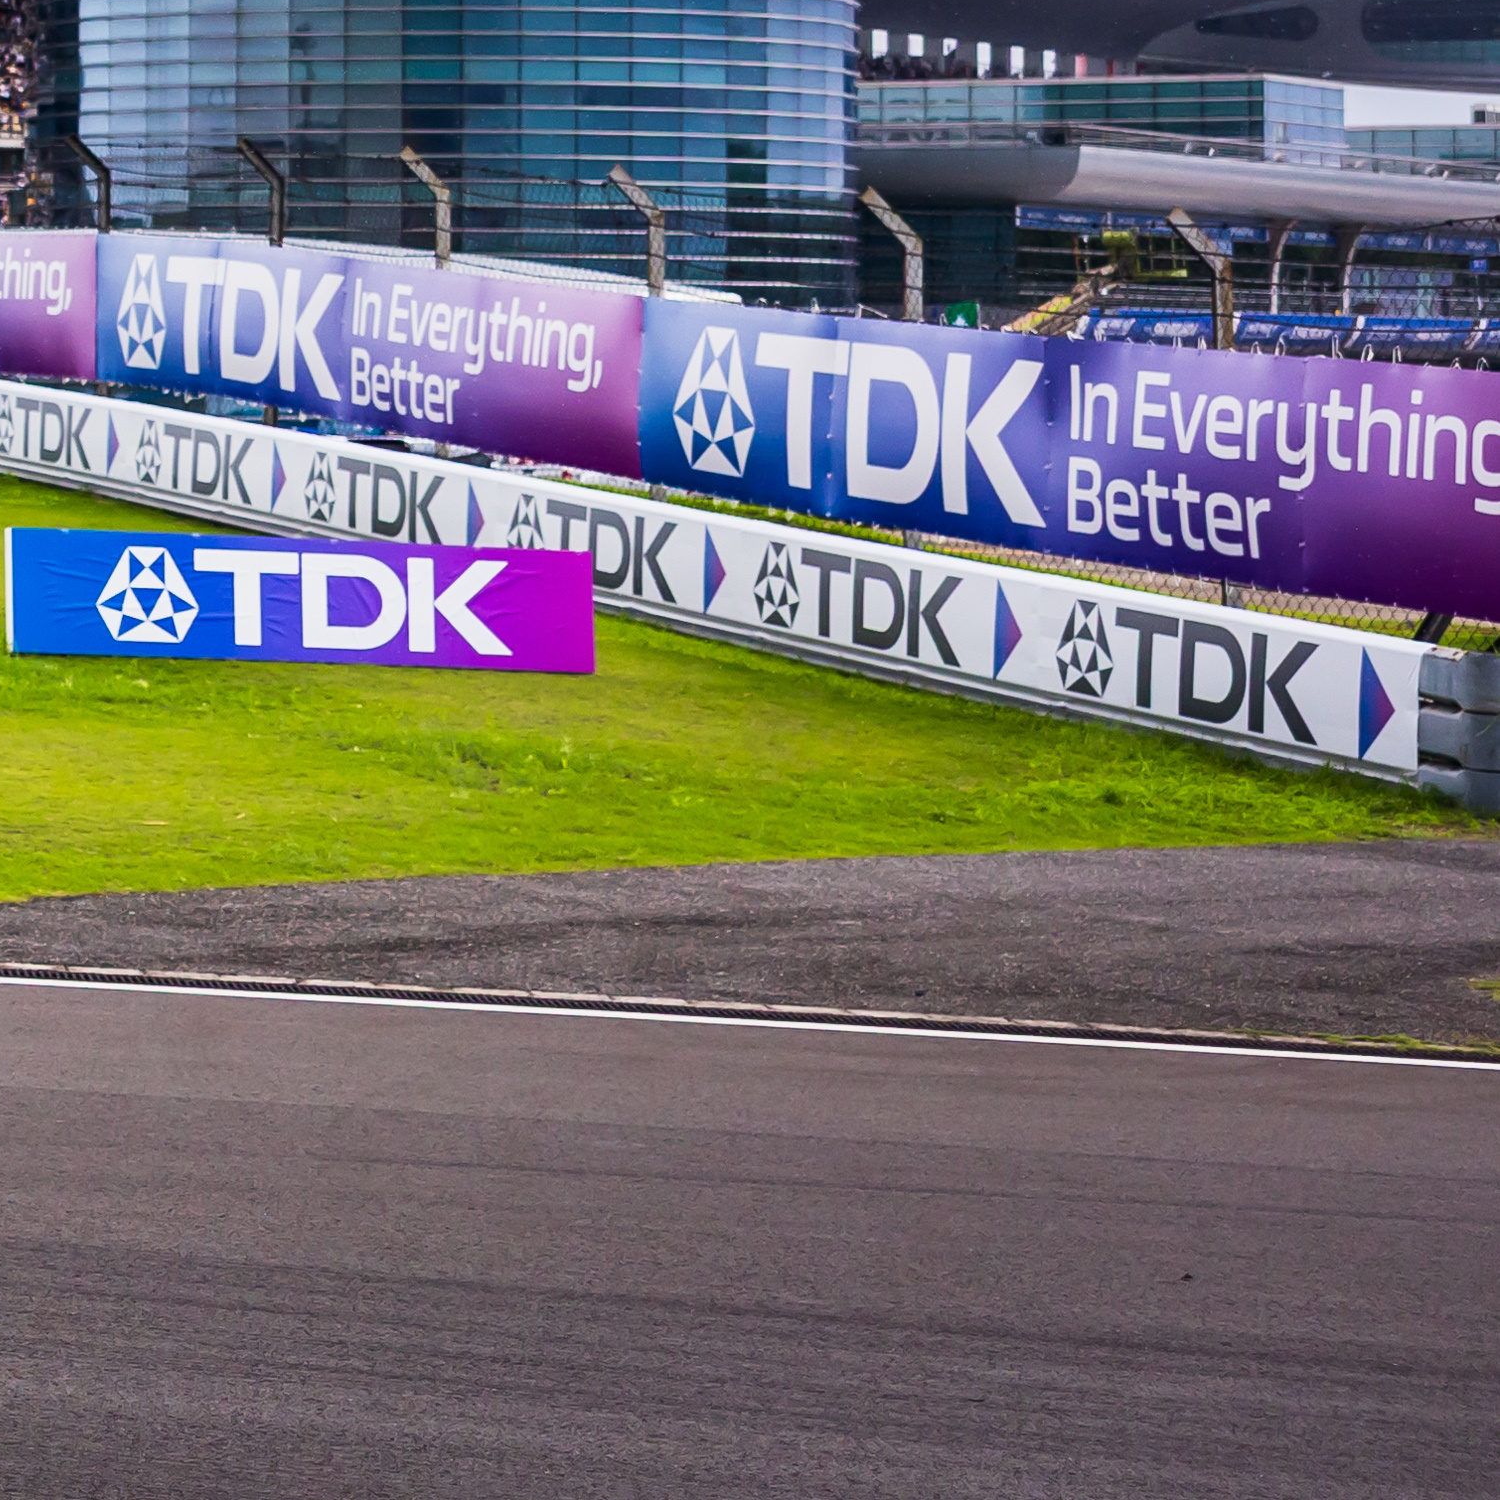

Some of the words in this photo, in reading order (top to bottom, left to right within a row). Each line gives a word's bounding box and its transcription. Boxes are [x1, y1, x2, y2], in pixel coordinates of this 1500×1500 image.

[166, 255, 346, 402] TDK
[351, 278, 382, 339] In
[387, 293, 603, 394] Everything,
[15, 397, 92, 472] TDK
[350, 347, 461, 425] Better
[754, 332, 1046, 528] TDK
[1070, 364, 1119, 444] In
[164, 423, 256, 505] TDK
[337, 457, 446, 545] TDK
[1067, 456, 1271, 560] Better
[193, 548, 513, 656] TDK
[547, 498, 678, 604] TDK
[801, 548, 964, 668] TDK
[1114, 607, 1320, 746] TDK
